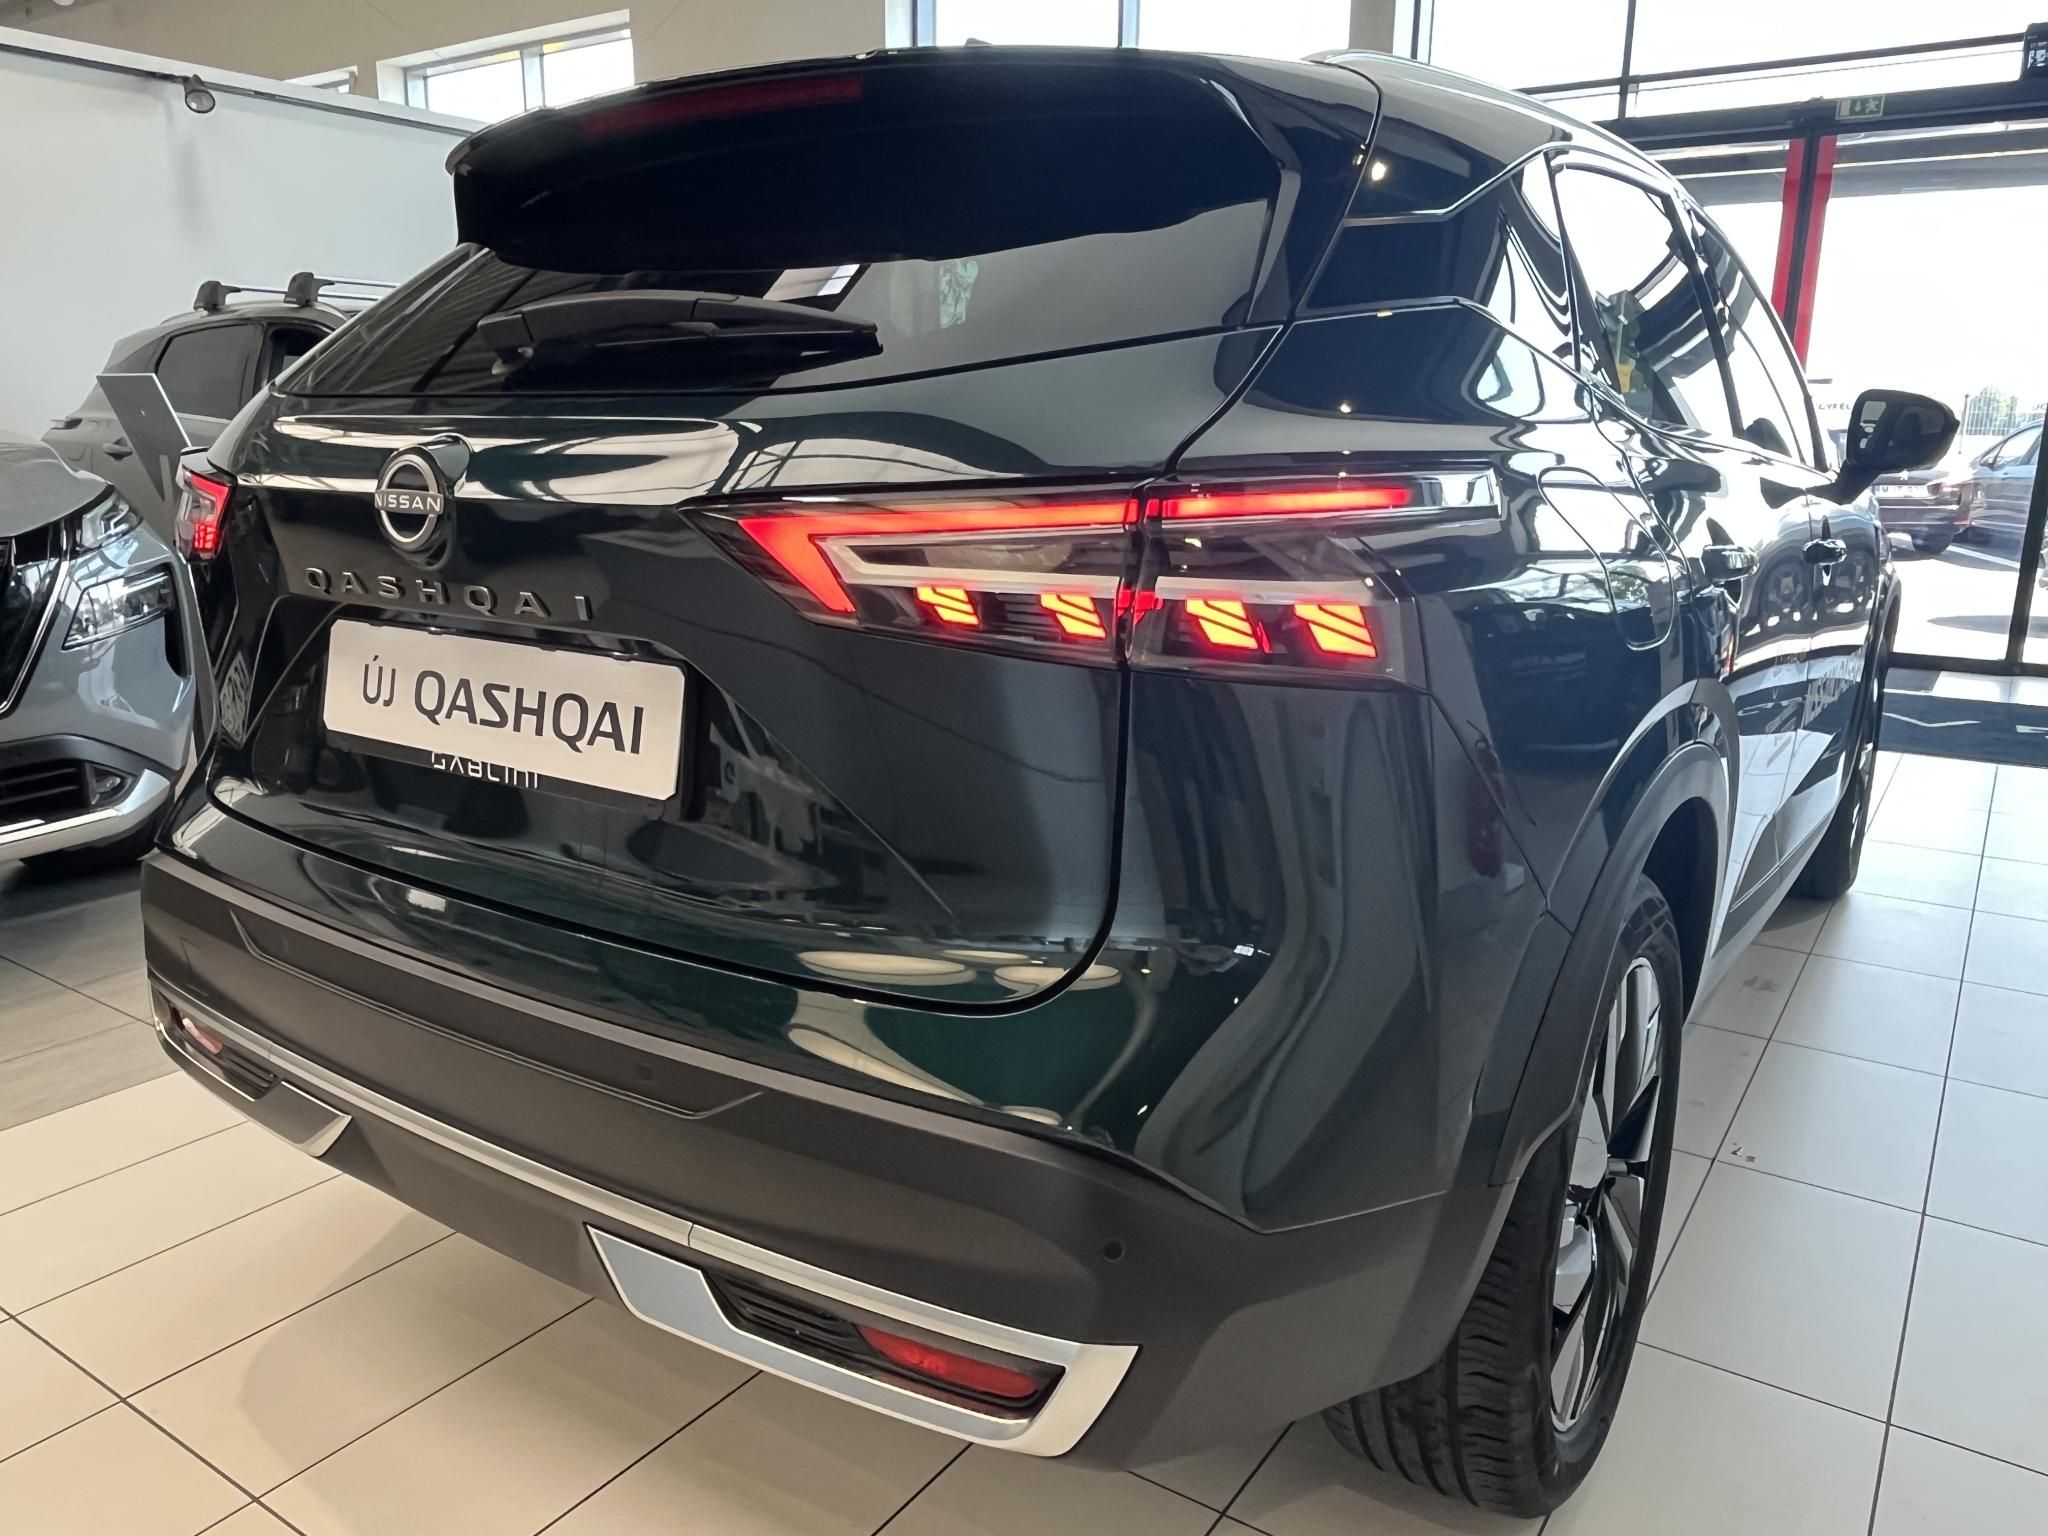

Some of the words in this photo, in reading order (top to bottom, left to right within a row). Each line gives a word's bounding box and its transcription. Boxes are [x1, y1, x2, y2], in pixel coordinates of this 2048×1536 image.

[375, 493, 441, 512] NISSAN
[305, 567, 593, 622] QASHQAI
[362, 655, 396, 707] ÚJ
[414, 670, 644, 754] QASHQAI
